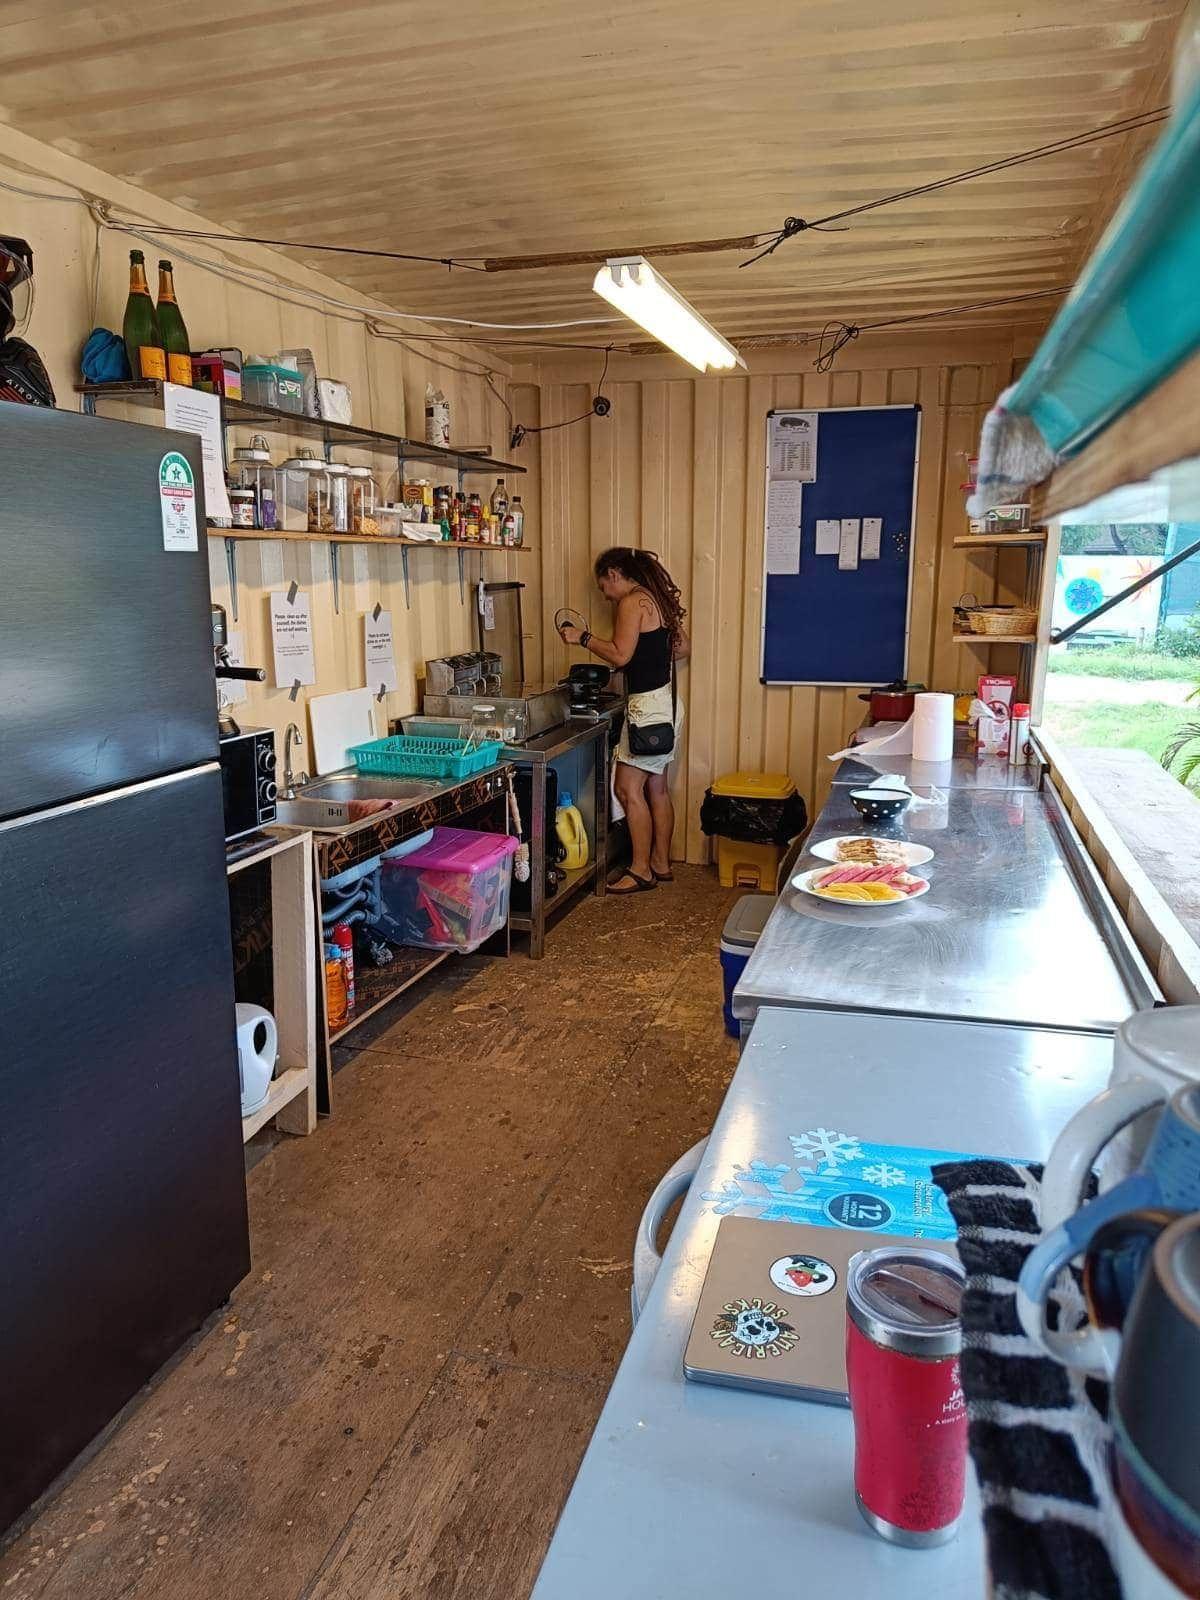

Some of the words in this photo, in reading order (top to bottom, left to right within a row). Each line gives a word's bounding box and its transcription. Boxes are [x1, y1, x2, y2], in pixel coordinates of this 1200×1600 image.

[858, 1204, 882, 1221] 12
[723, 1297, 788, 1320] SOCKS
[709, 1329, 800, 1360] AMERICAN
